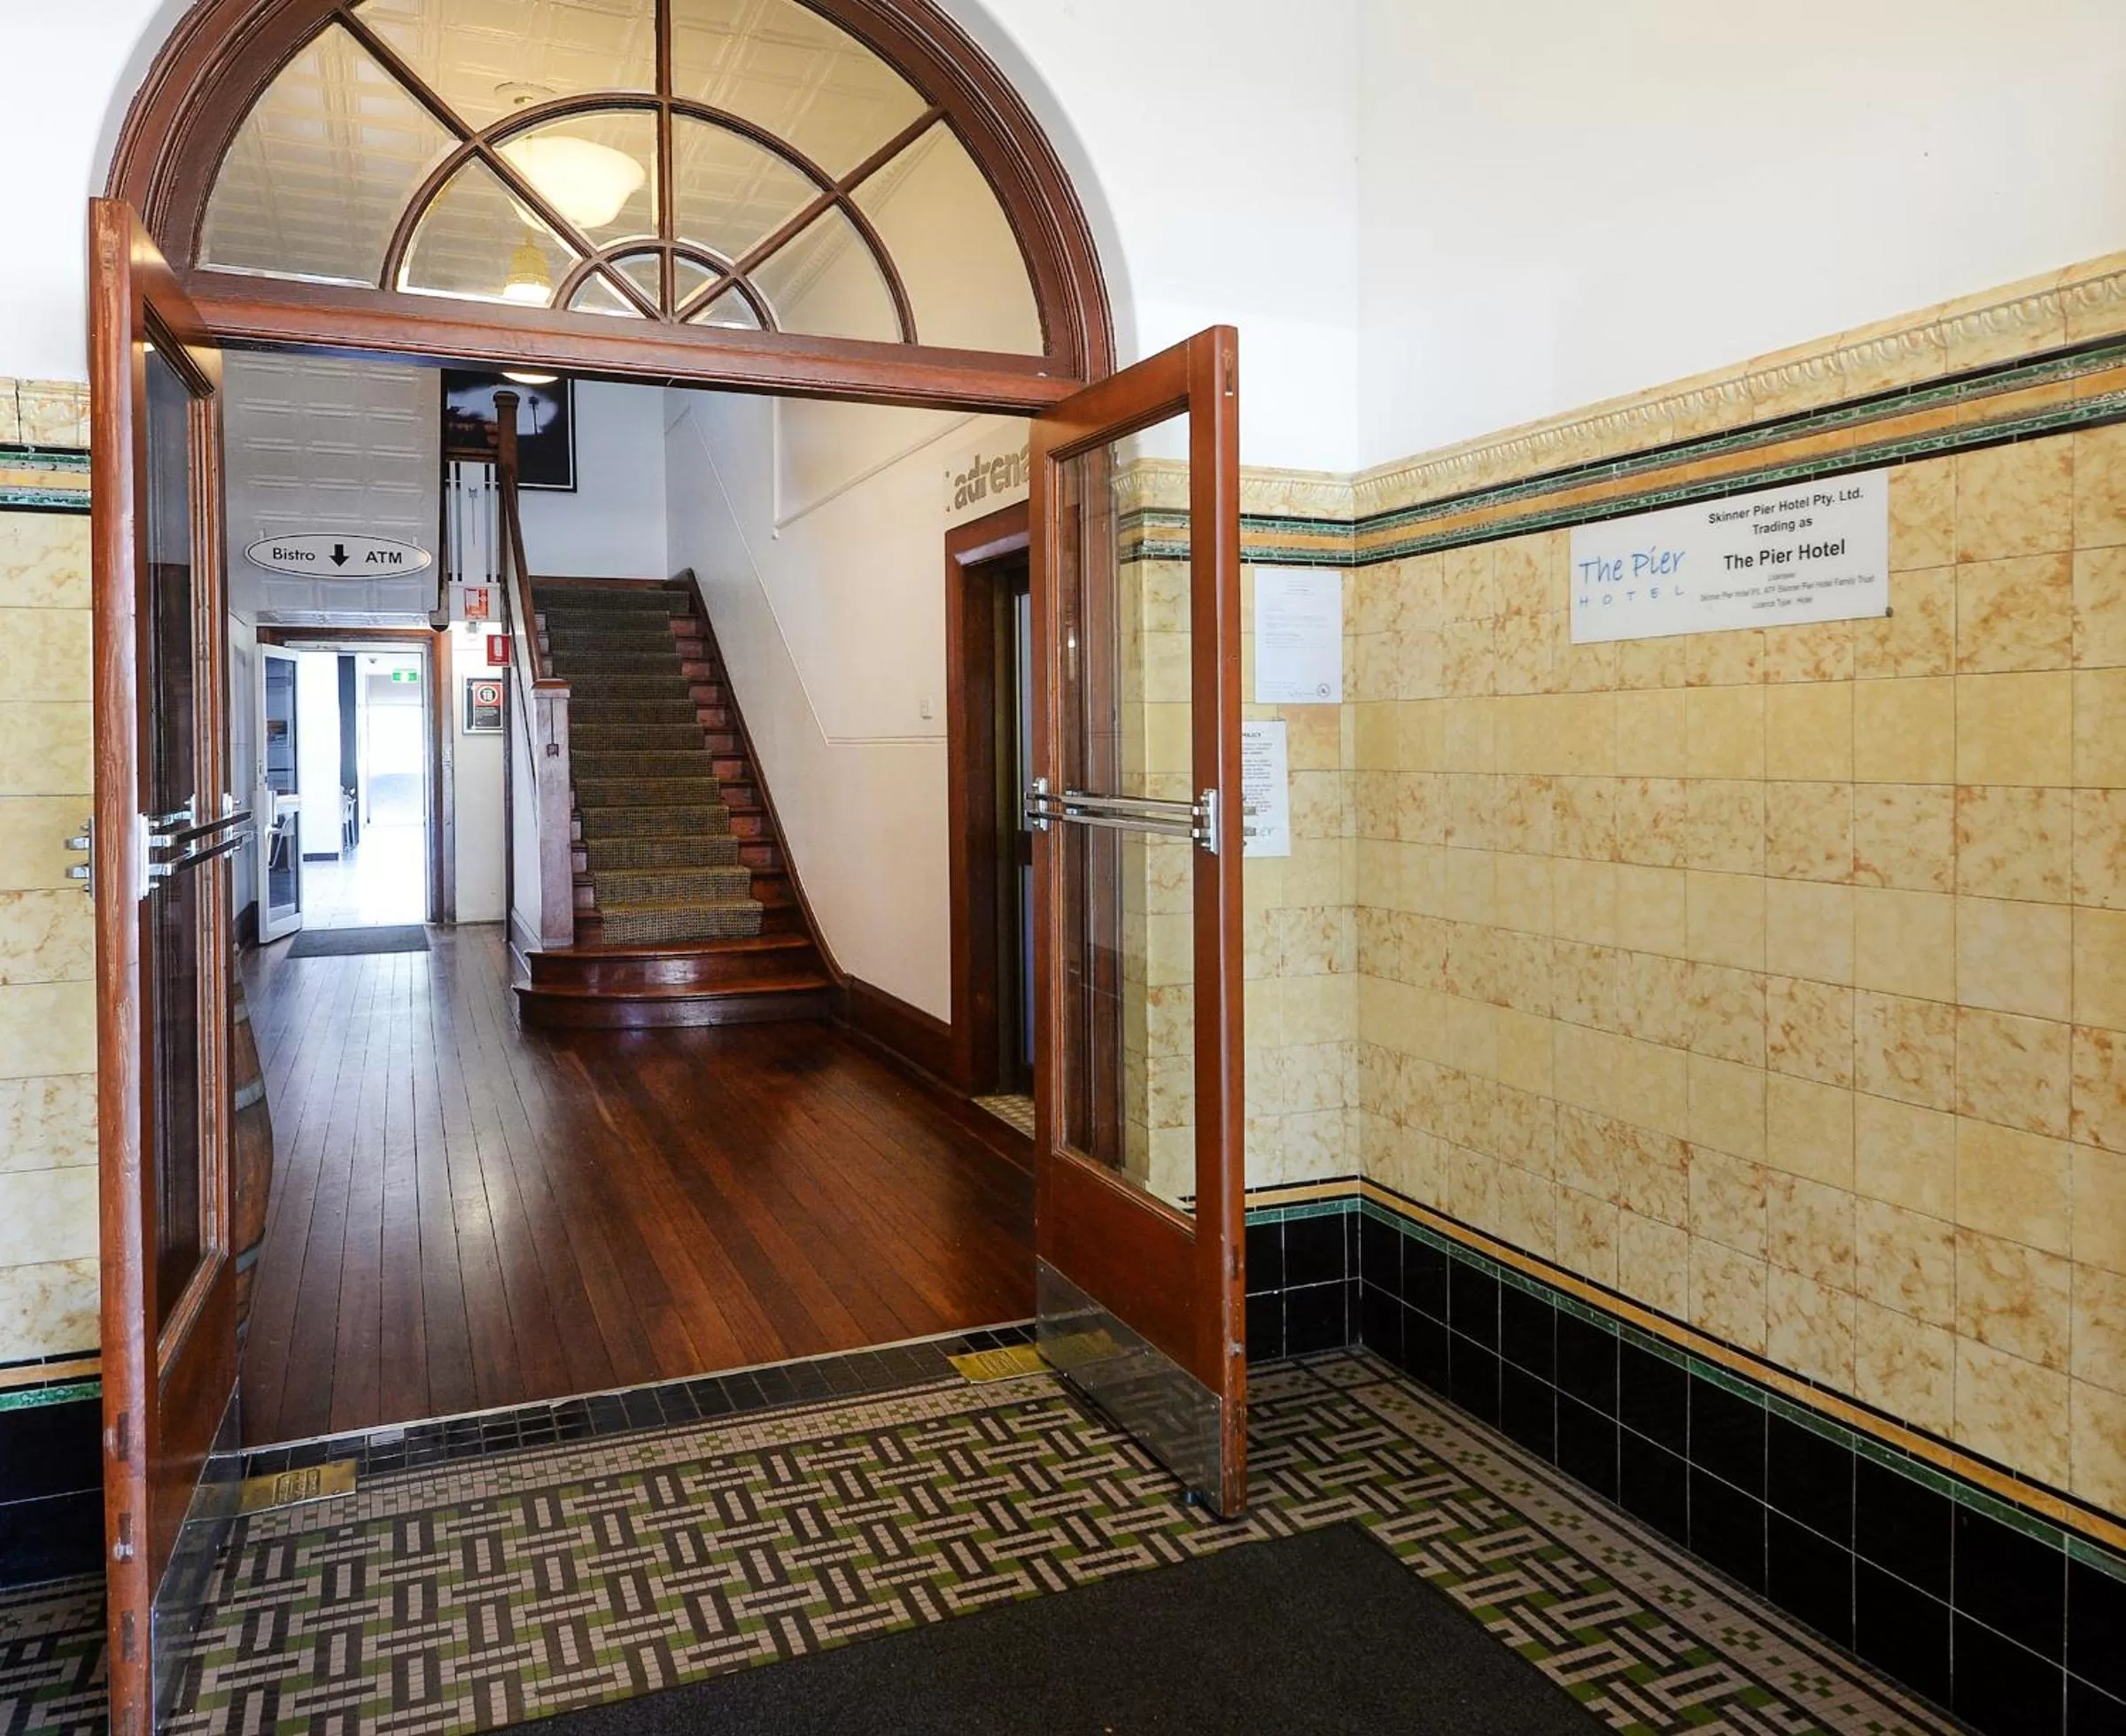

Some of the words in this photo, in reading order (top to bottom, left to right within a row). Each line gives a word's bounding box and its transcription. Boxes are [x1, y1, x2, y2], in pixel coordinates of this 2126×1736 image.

[1708, 508, 1750, 524] Skinner
[1753, 504, 1775, 517] Pier
[1779, 497, 1810, 512] Hotel
[1813, 493, 1835, 508] Pty.
[1839, 487, 1864, 501] Ltd.
[1752, 520, 1796, 535] Trading
[1799, 517, 1813, 528] as
[272, 546, 315, 562] Bistro
[365, 550, 402, 564] ATM
[1578, 555, 1623, 585] The
[1631, 545, 1686, 577] Pier
[1723, 554, 1753, 571] The
[1759, 548, 1793, 566] Pier
[1798, 538, 1845, 561] Hotel
